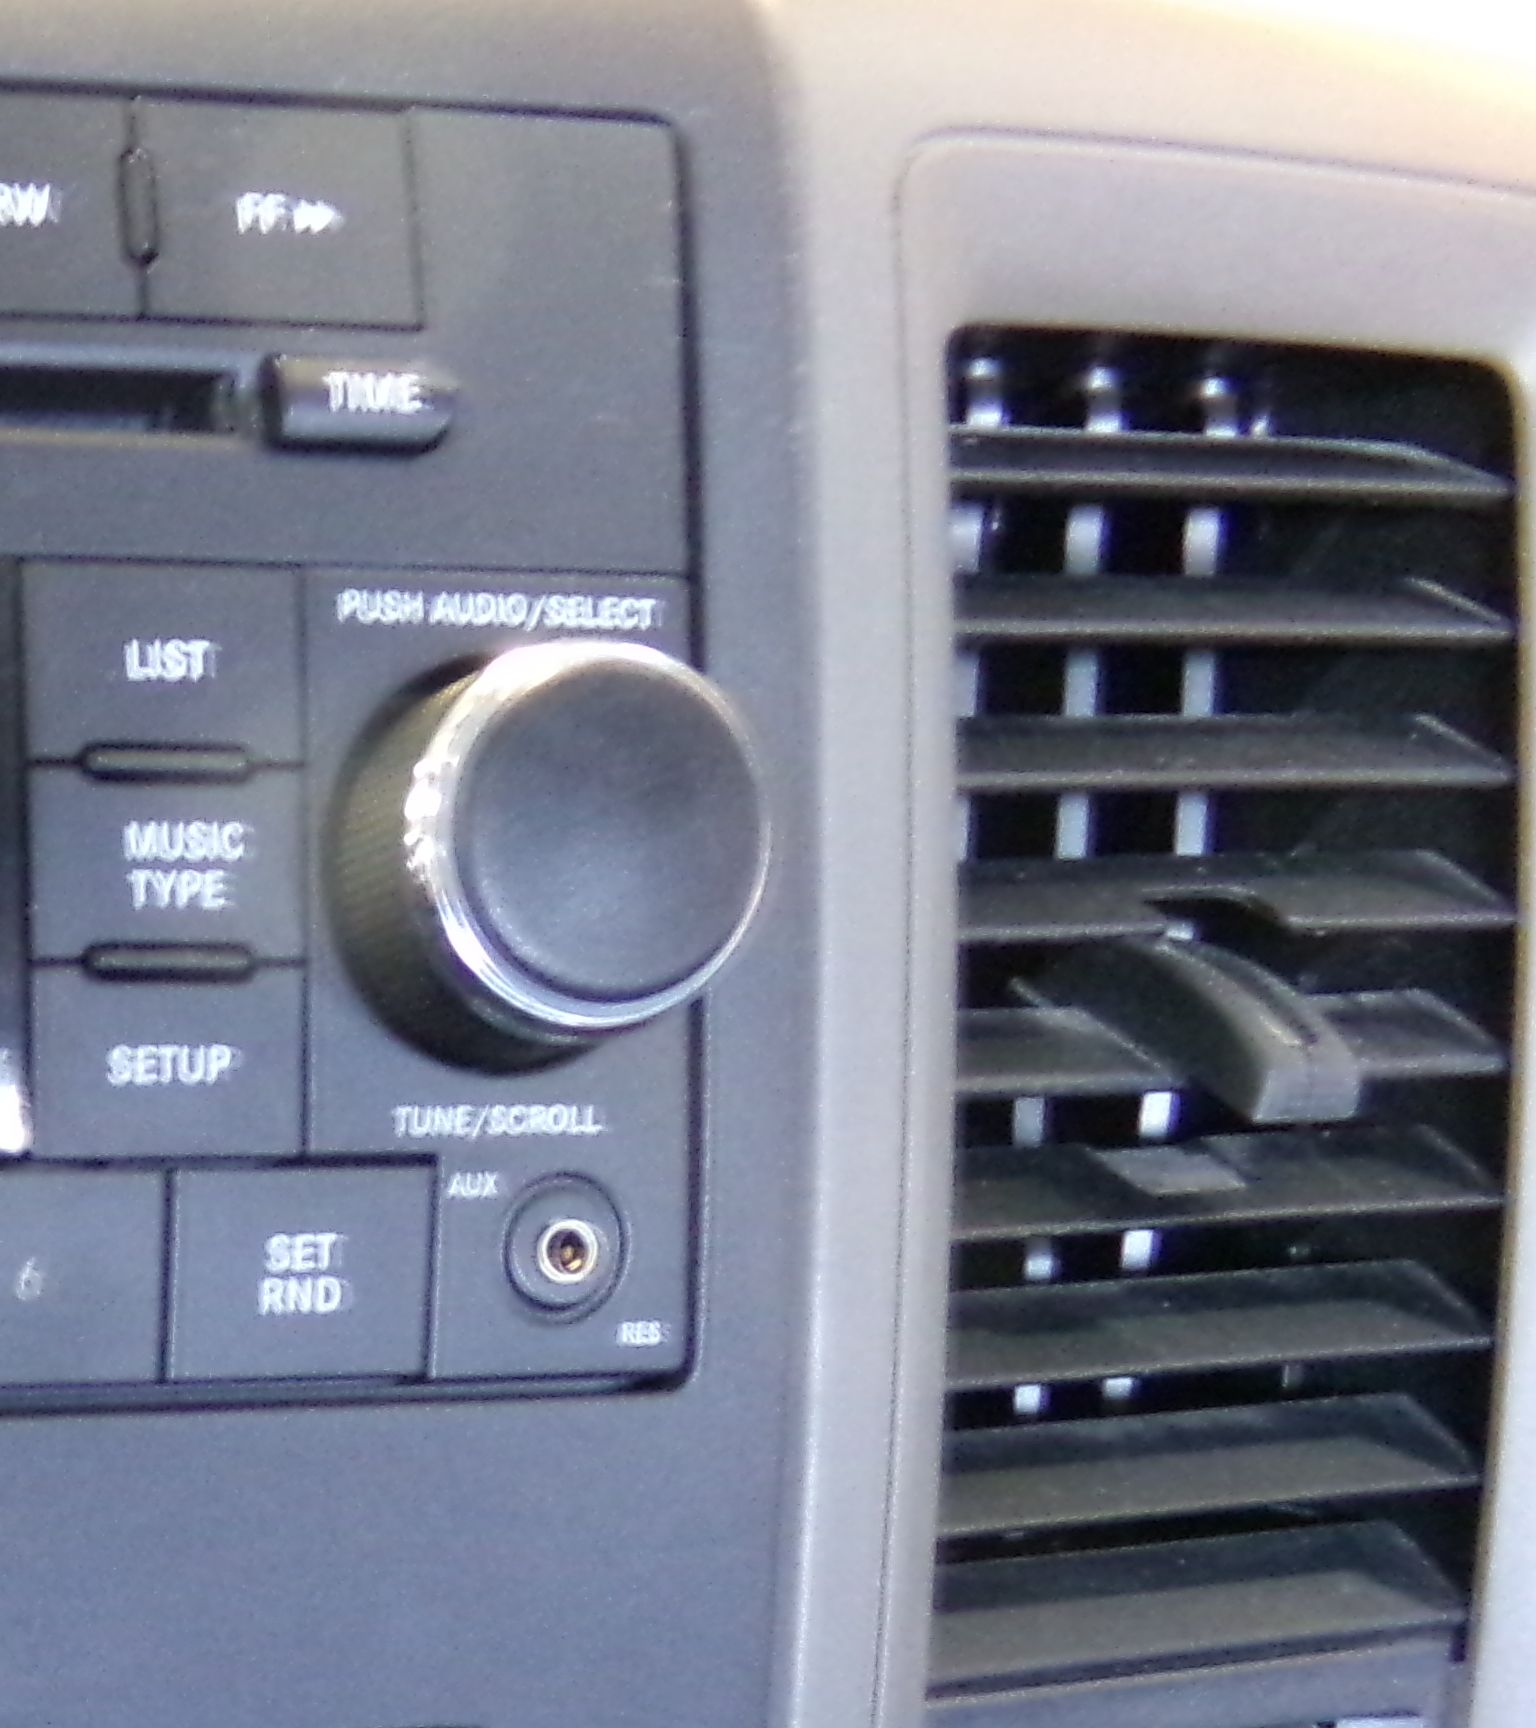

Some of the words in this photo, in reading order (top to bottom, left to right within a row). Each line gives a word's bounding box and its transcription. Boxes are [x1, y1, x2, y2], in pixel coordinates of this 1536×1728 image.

[322, 370, 426, 414] TIME
[336, 587, 424, 625] PUSH
[427, 589, 660, 631] AUDIO/SELECT
[124, 638, 217, 683] LIST
[124, 820, 252, 864] MUSIC
[128, 867, 234, 911] TYPE
[105, 1043, 237, 1087] SETUP
[391, 1102, 606, 1140] TUNE/SCROLL
[446, 1171, 500, 1200] AUX
[264, 1231, 345, 1272] SET
[13, 1256, 47, 1302] 6
[258, 1274, 344, 1315] RND
